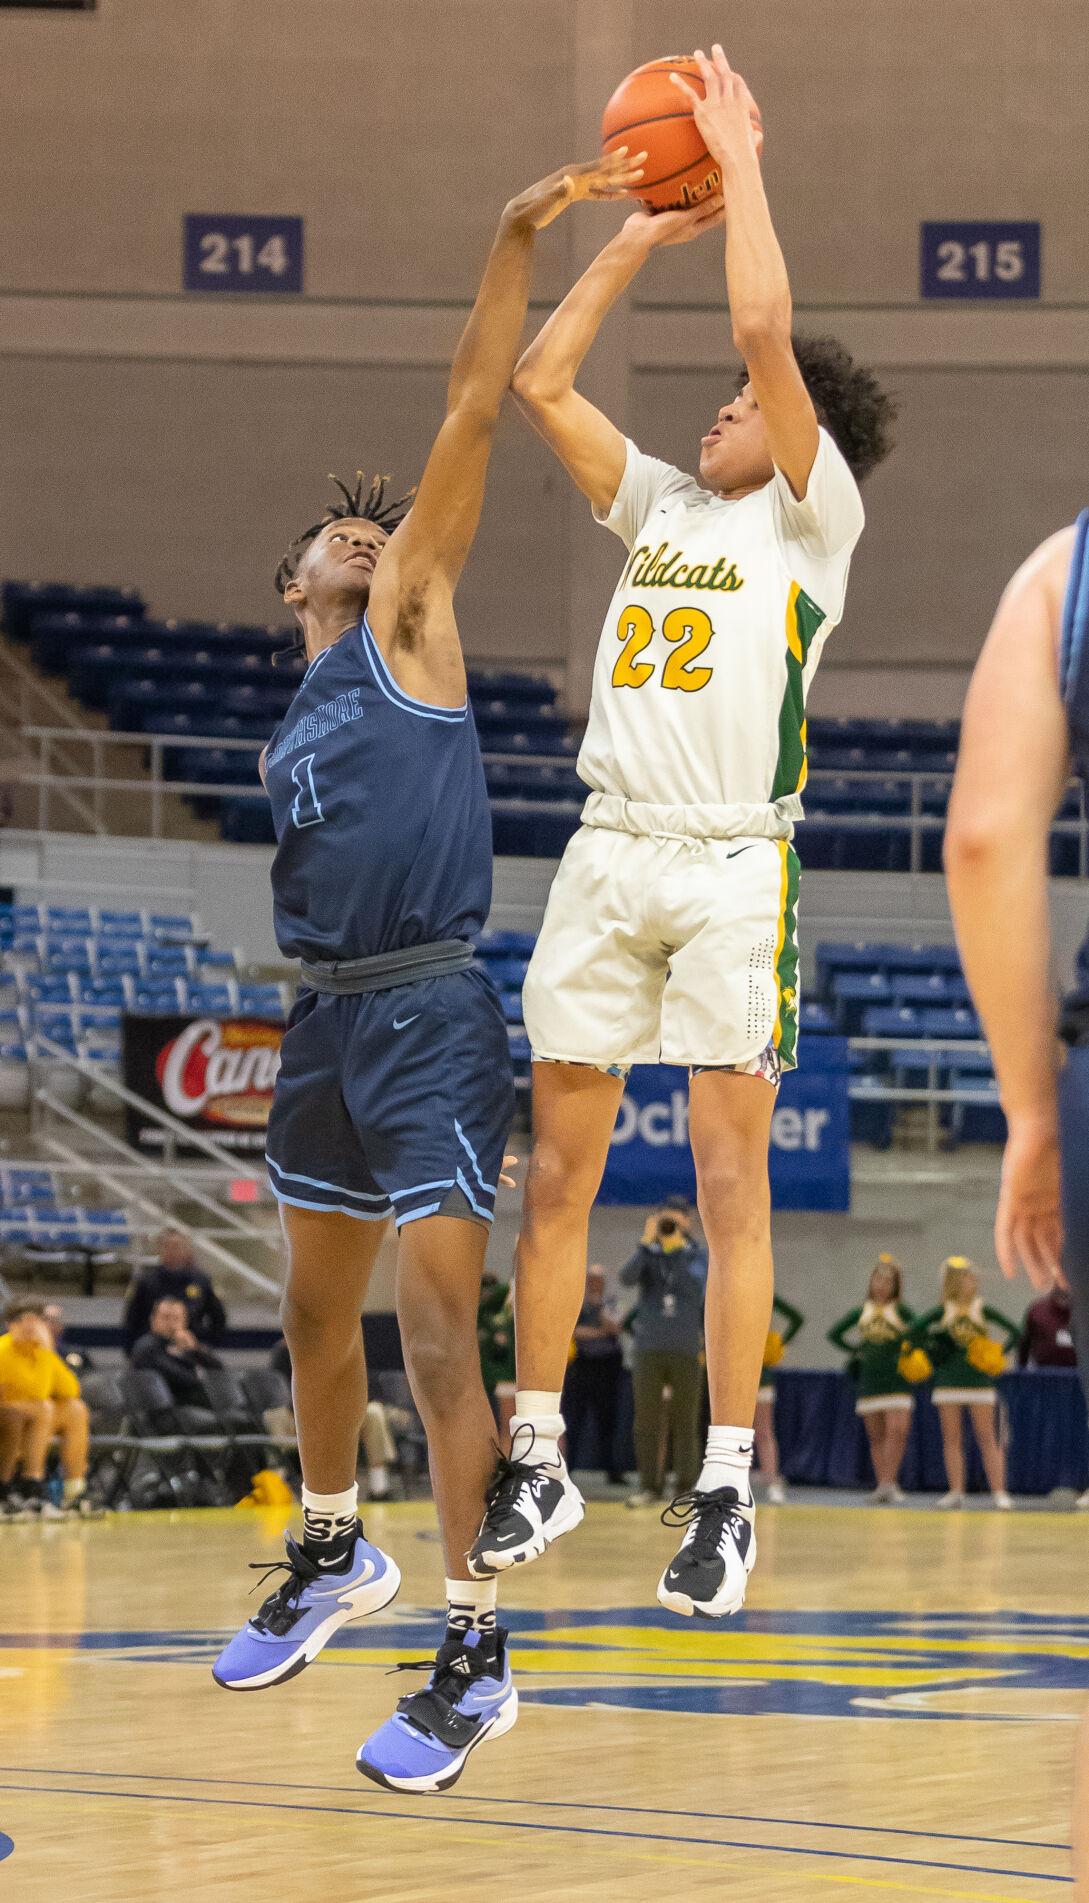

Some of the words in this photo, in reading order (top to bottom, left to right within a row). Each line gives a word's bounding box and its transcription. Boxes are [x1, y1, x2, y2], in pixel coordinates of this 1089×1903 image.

[200, 233, 287, 275] 214
[936, 241, 1024, 281] 215
[612, 604, 716, 692] 22
[291, 752, 326, 829] 1
